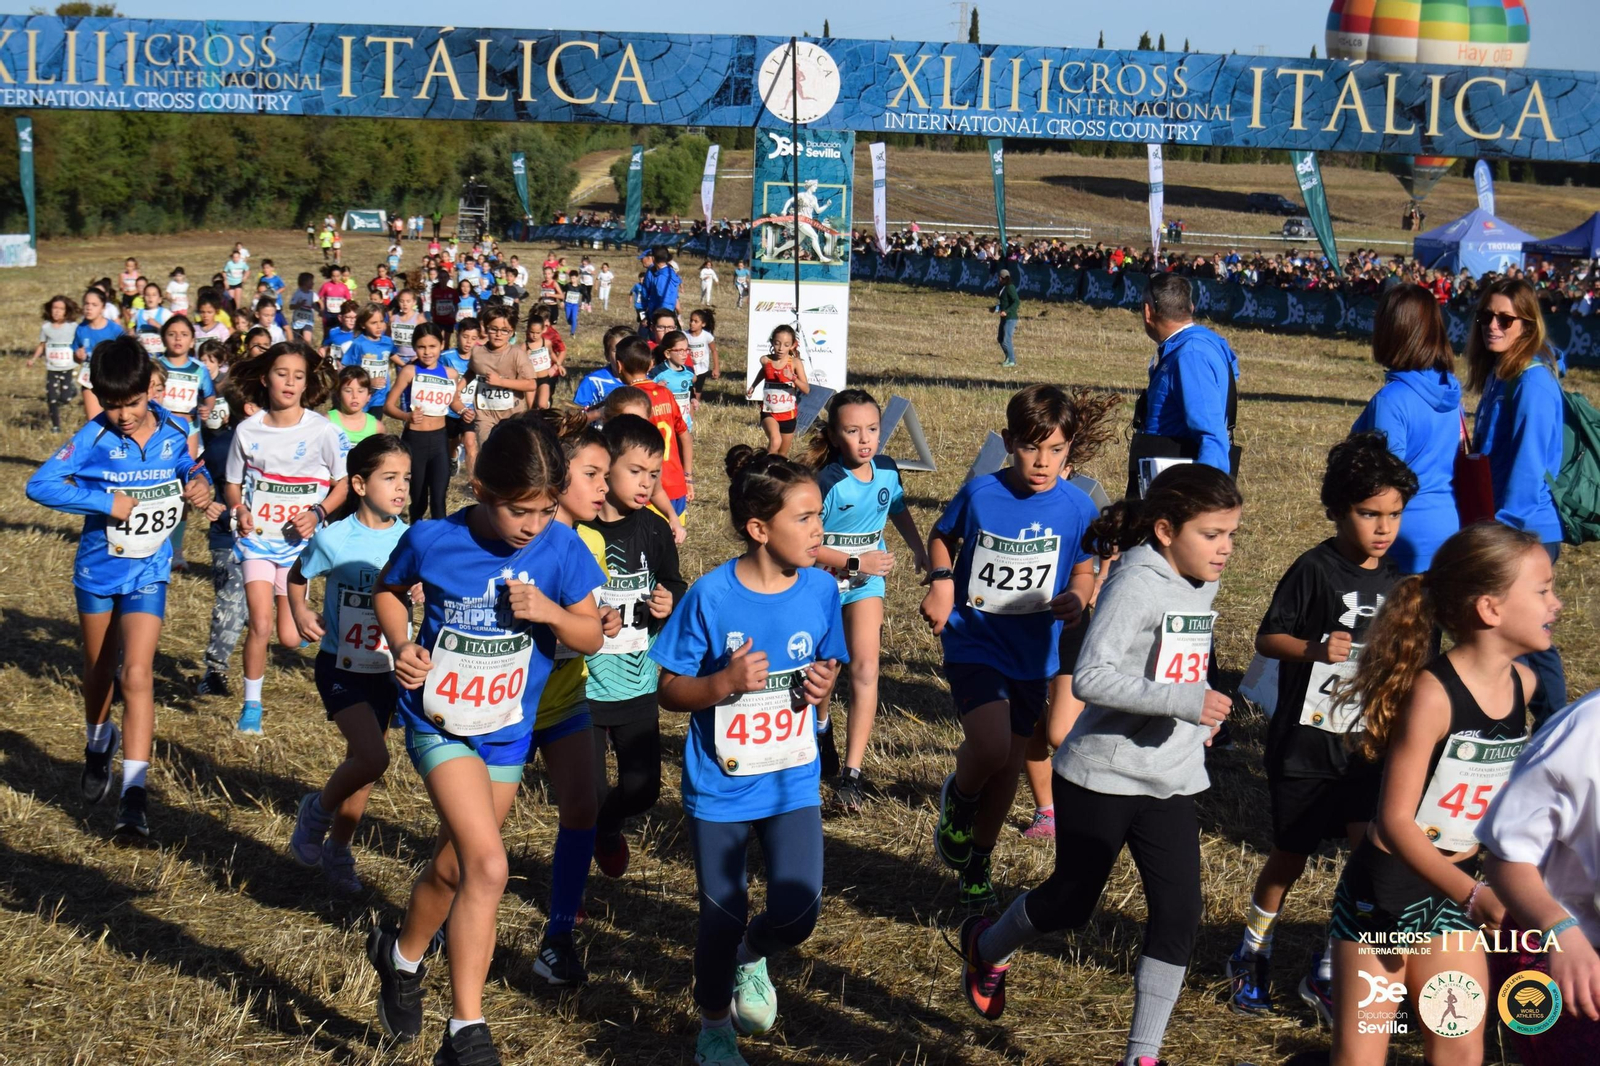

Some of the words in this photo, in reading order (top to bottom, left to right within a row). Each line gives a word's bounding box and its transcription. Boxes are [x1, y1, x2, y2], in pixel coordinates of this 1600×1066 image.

[144, 33, 276, 68] CROSS
[1458, 44, 1488, 66] Hay
[337, 26, 657, 105] ITÁLICA
[144, 70, 325, 91] INTERNACIONAL
[886, 53, 1053, 114] XLIII
[1059, 61, 1188, 98] CROSS
[134, 91, 195, 110] CROSS
[198, 92, 293, 111] COUNTRY
[1058, 97, 1234, 121] INTERNACIONAL
[1247, 59, 1561, 142] ITÁLICA
[885, 112, 1042, 135] INTERNATIONAL
[1046, 119, 1105, 136] CROSS
[1110, 122, 1203, 141] COUNTRY
[805, 148, 841, 158] Sevilla
[415, 389, 452, 406] 4480
[765, 393, 793, 405] 4344
[131, 488, 166, 500] ITÁLICA
[272, 483, 304, 493] ITÁLICA
[115, 506, 177, 536] 4283
[839, 535, 870, 545] ITÁLICA
[998, 541, 1038, 553] ITÁLICA
[978, 562, 1051, 591] 4237
[464, 640, 515, 654] ITÁLICA
[435, 667, 524, 708] 4460
